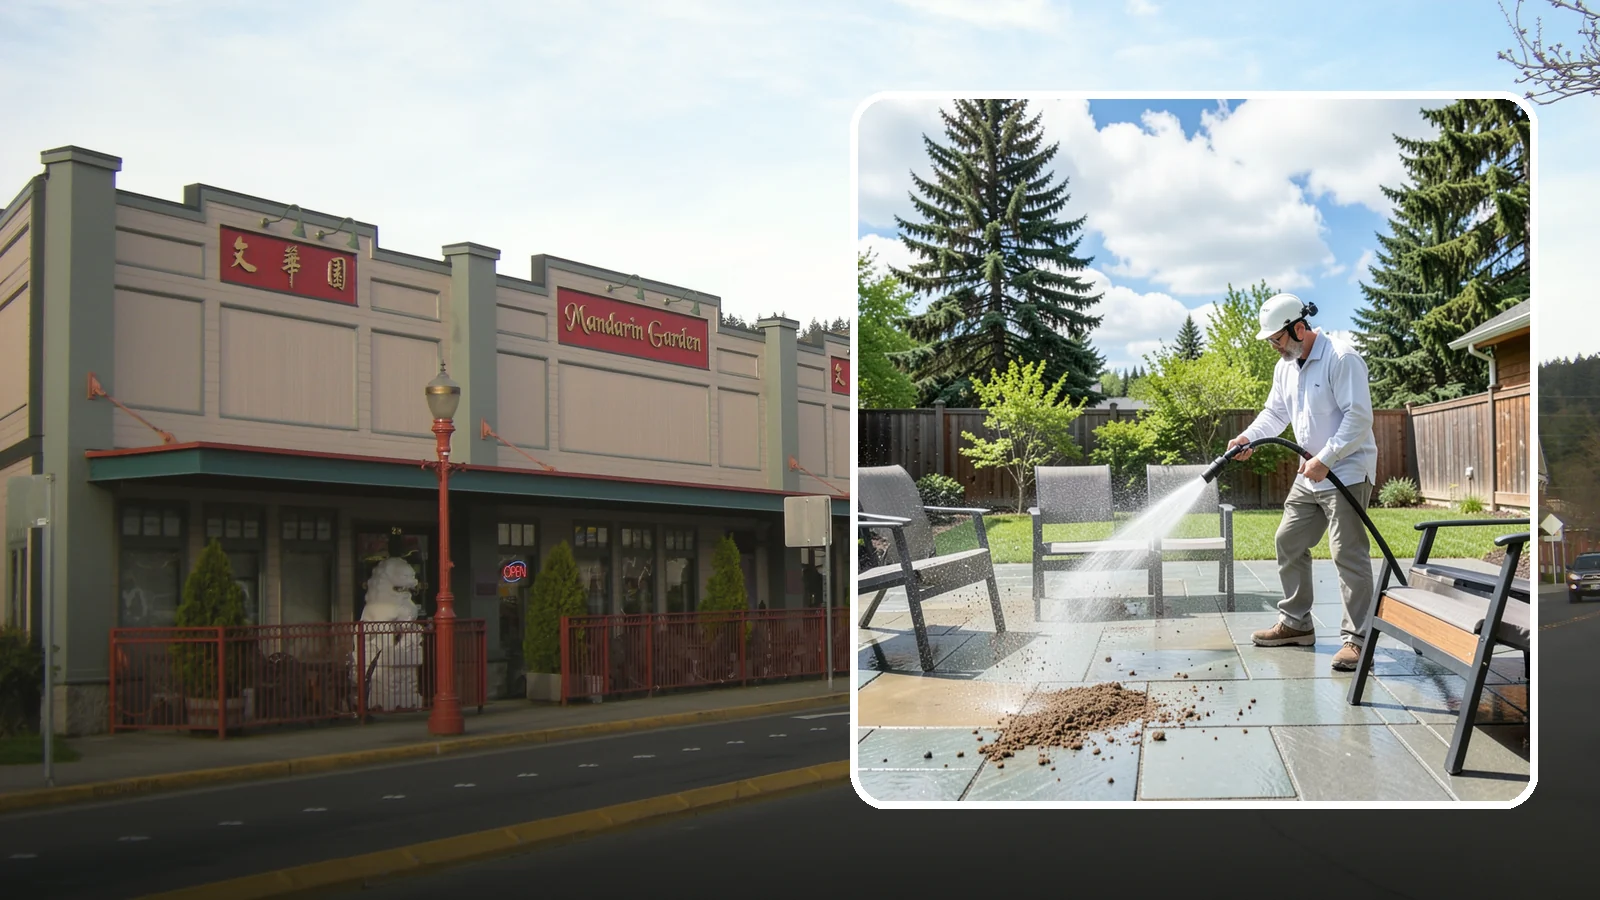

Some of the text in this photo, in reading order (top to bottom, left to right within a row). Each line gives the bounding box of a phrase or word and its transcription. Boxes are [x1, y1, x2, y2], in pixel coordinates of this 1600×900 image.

[564, 302, 701, 352] Mandarin Garden
[503, 566, 526, 578] OPEN
